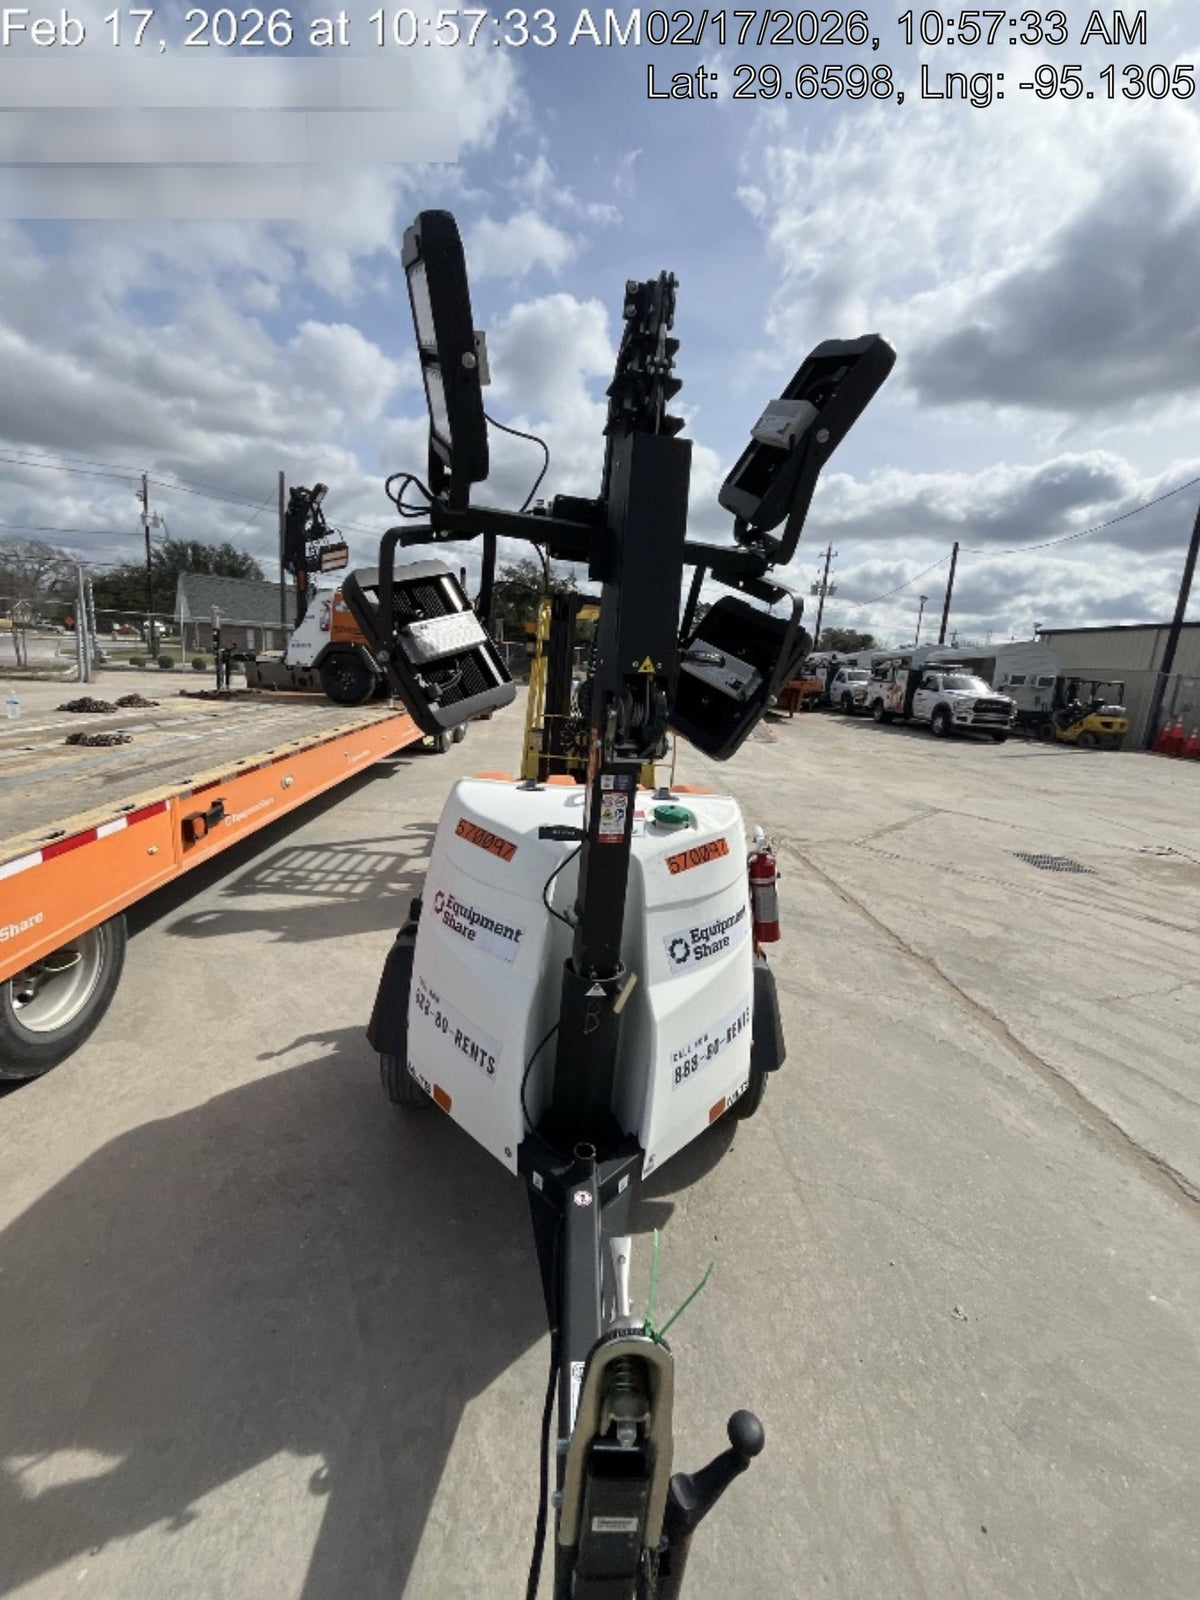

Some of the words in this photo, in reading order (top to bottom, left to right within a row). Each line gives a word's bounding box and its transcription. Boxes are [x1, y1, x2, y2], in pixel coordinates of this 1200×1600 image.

[441, 910, 477, 941] Share
[445, 894, 524, 943] Equipment
[693, 936, 730, 961] Share
